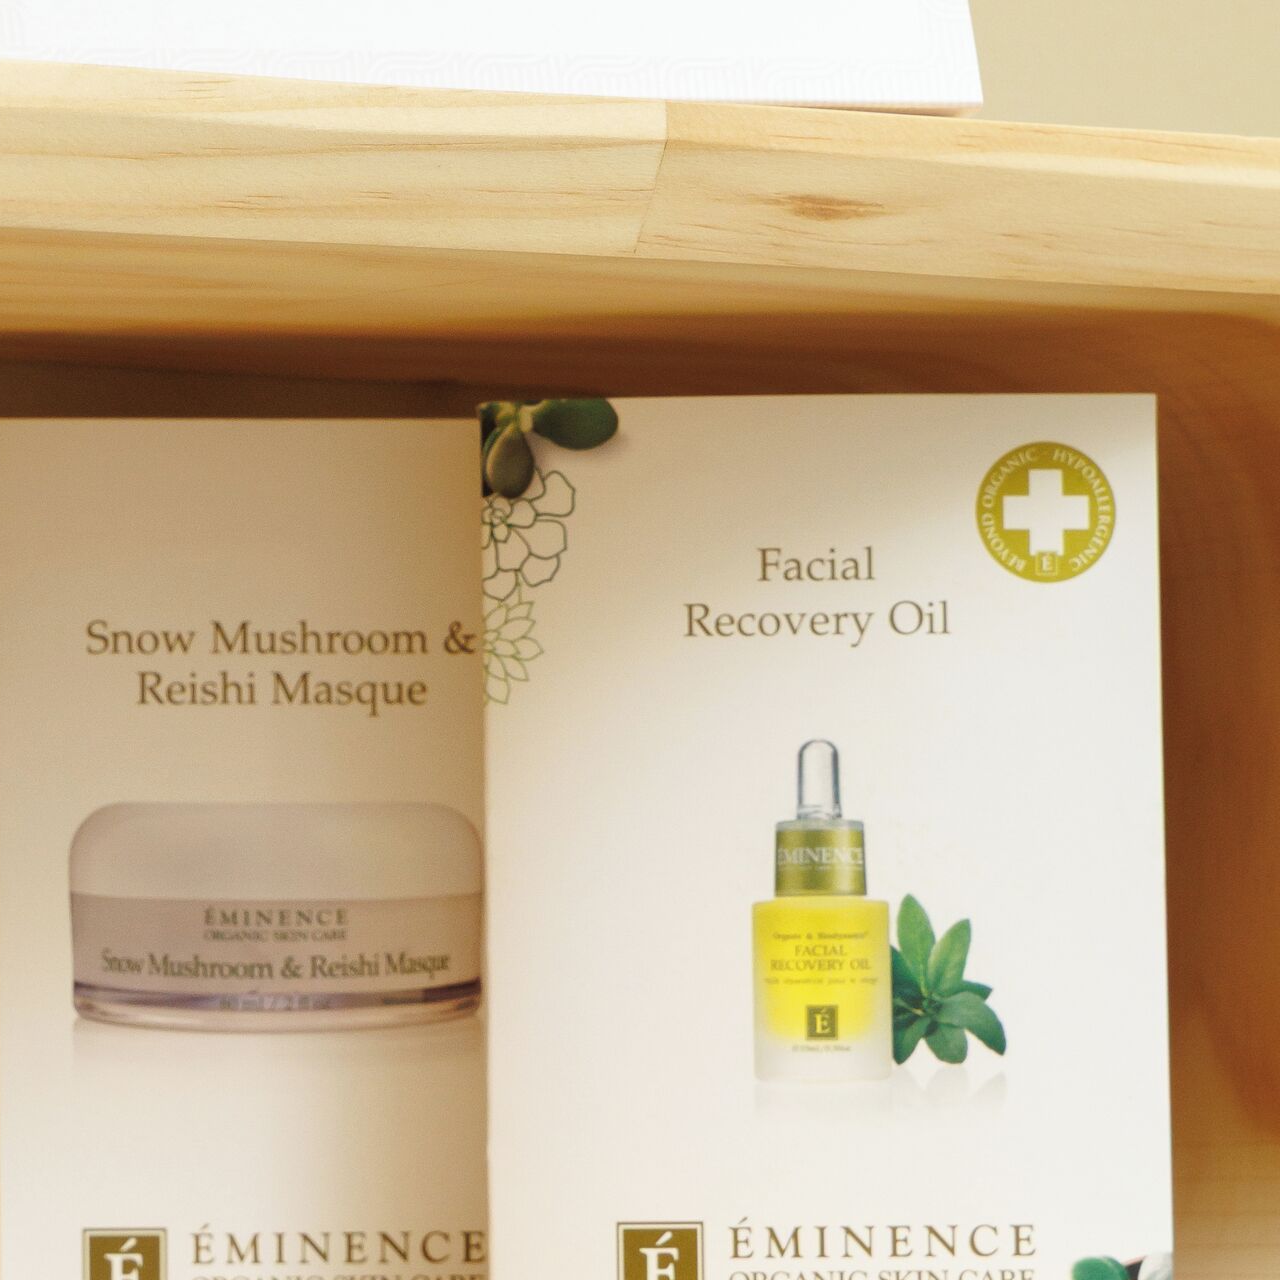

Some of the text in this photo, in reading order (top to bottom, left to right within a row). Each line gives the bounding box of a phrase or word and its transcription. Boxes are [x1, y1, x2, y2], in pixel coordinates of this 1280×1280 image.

[982, 448, 1039, 571] BEYOND ORGANIC
[1052, 448, 1112, 571] HYPOALLERGENIC
[757, 545, 875, 582] Facial
[86, 619, 477, 655] Snow Mushroom &
[684, 599, 950, 645] Recovery Oil
[138, 670, 429, 718] Reishi Masque
[101, 948, 143, 973] Snow
[148, 951, 274, 980] Mushroom
[280, 954, 303, 979] &
[310, 952, 380, 979] Reishi
[770, 959, 845, 972] RECOVERY
[794, 944, 848, 956] FACIAL
[190, 1223, 487, 1265] ÉMINENCE
[729, 1216, 1037, 1259] ÉMINENCE
